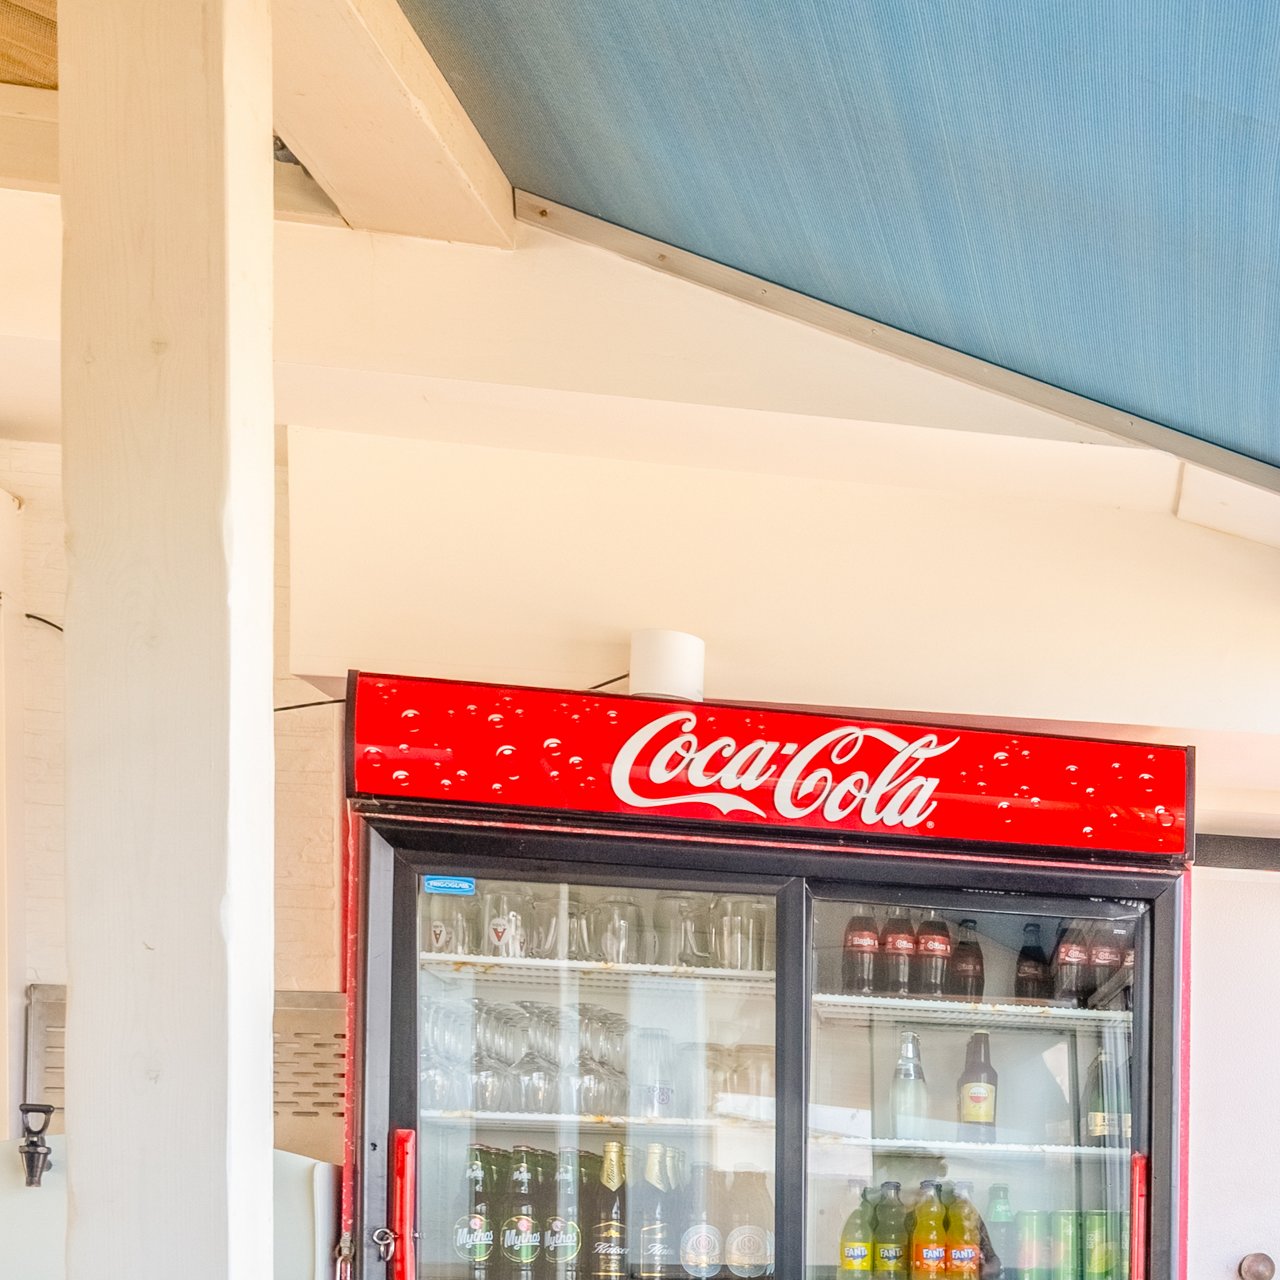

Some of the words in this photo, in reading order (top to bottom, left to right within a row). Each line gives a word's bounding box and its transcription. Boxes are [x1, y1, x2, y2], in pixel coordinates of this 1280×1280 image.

[610, 710, 961, 828] Coca-Cola
[456, 1228, 494, 1249] Mythos
[504, 1229, 541, 1250] Mythos
[922, 1247, 945, 1258] FANT
